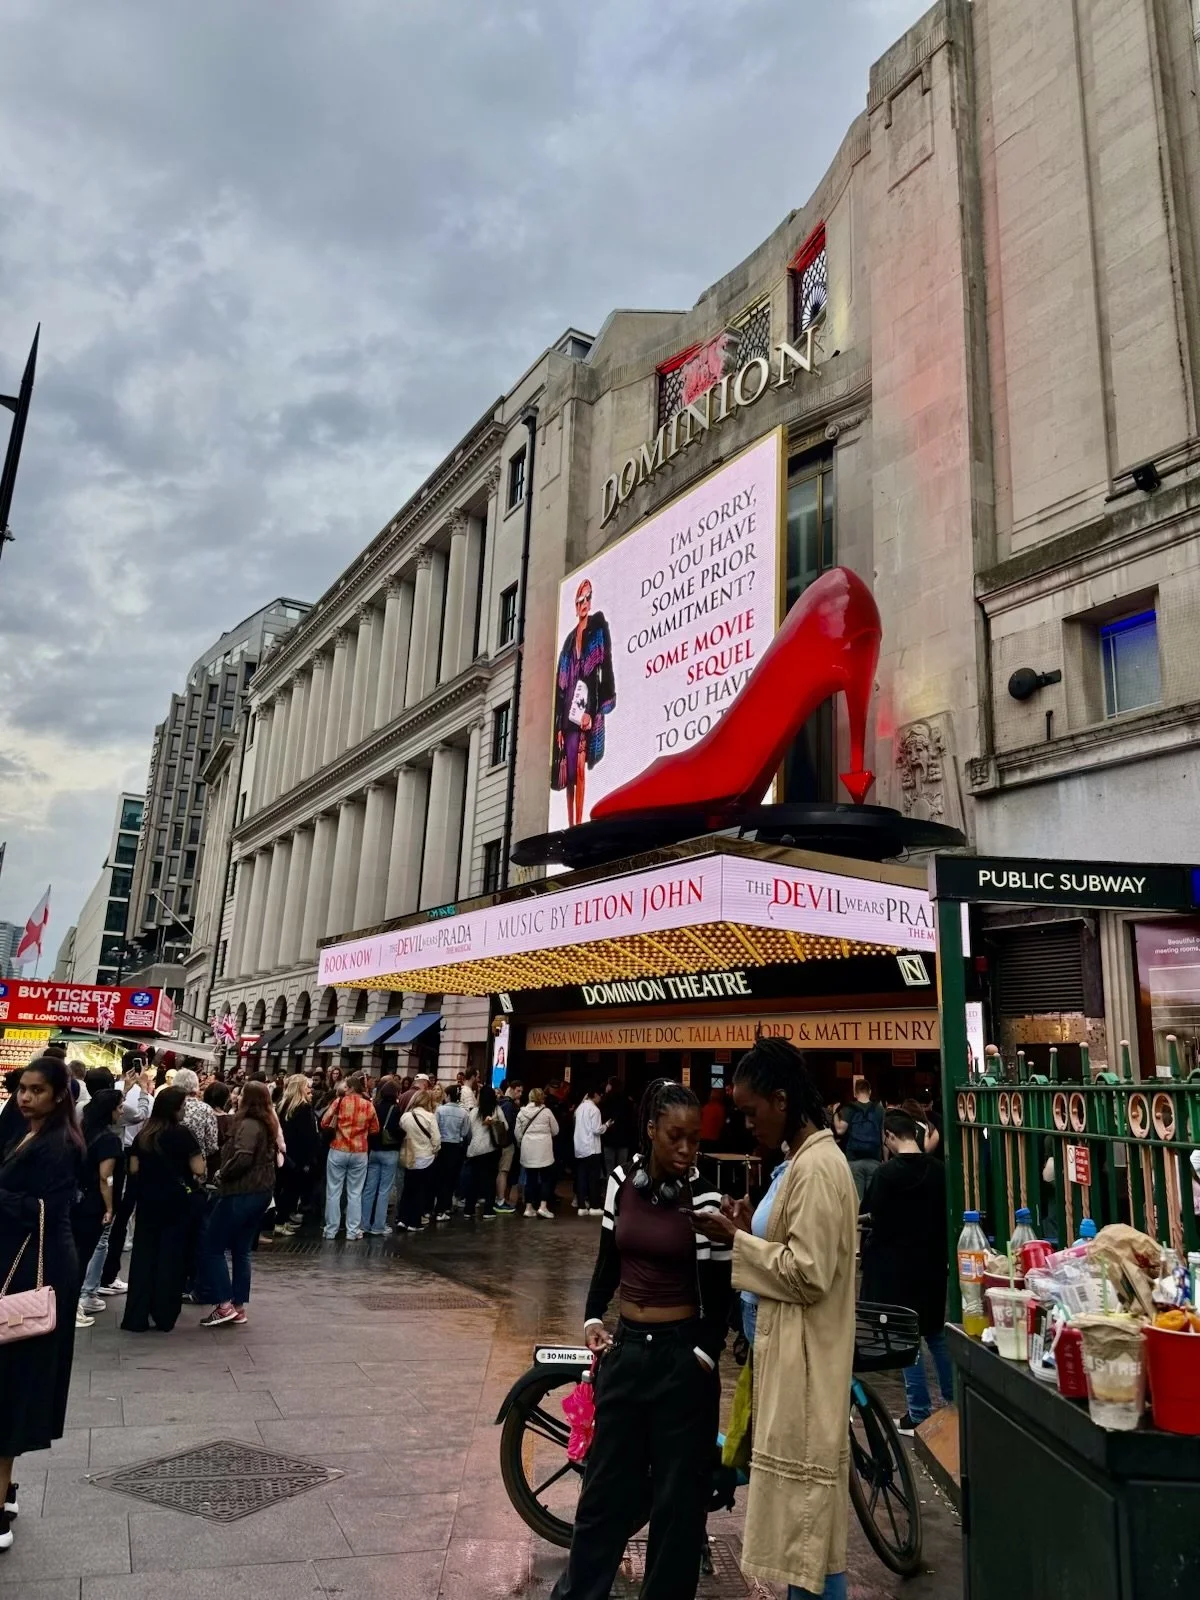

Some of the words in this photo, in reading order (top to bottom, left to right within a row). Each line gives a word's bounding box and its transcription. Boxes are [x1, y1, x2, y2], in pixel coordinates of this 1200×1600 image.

[600, 325, 820, 529] DOMINION
[669, 529, 695, 556] I'M
[697, 484, 757, 539] SORRY,
[640, 570, 664, 599] DO
[669, 548, 703, 582] YOU
[709, 513, 757, 556] HAVE
[651, 575, 695, 617] SOME
[701, 542, 757, 587] PRIOR
[627, 571, 756, 654] COMMITMENT?
[645, 641, 688, 679] SOME
[693, 608, 755, 656] MOVIE
[687, 639, 755, 686] SEQUEL
[663, 690, 700, 722] YOU
[656, 728, 679, 752] TO
[684, 715, 711, 741] GO
[745, 879, 772, 897] THE
[768, 878, 846, 919] DEVIL
[846, 897, 885, 916] WEARS
[978, 869, 1055, 890] PUBLIC
[1060, 873, 1146, 894] SUBWAY
[498, 909, 545, 940] MUSIC
[551, 904, 570, 930] BY
[574, 890, 634, 926] ELTON
[641, 875, 704, 921] JOHN
[395, 934, 423, 961] DEVIL
[438, 924, 472, 948] PRADA
[908, 928, 926, 939] THE
[324, 953, 348, 974] BOOK
[350, 949, 372, 970] NOW
[18, 986, 54, 999] BUY
[56, 988, 121, 1004] TICKETS
[47, 1000, 90, 1014] HERE
[582, 979, 666, 1006] DOMINION
[665, 971, 752, 1001] THEATRE
[35, 1014, 70, 1022] LONDON
[532, 1031, 567, 1046] VANESSA
[617, 1027, 652, 1044] STEVIE
[655, 1026, 684, 1043] DOC,
[688, 1025, 722, 1042] TAILA
[798, 1022, 811, 1041] &
[814, 1022, 863, 1041] MATT
[868, 1020, 935, 1041] HENRY
